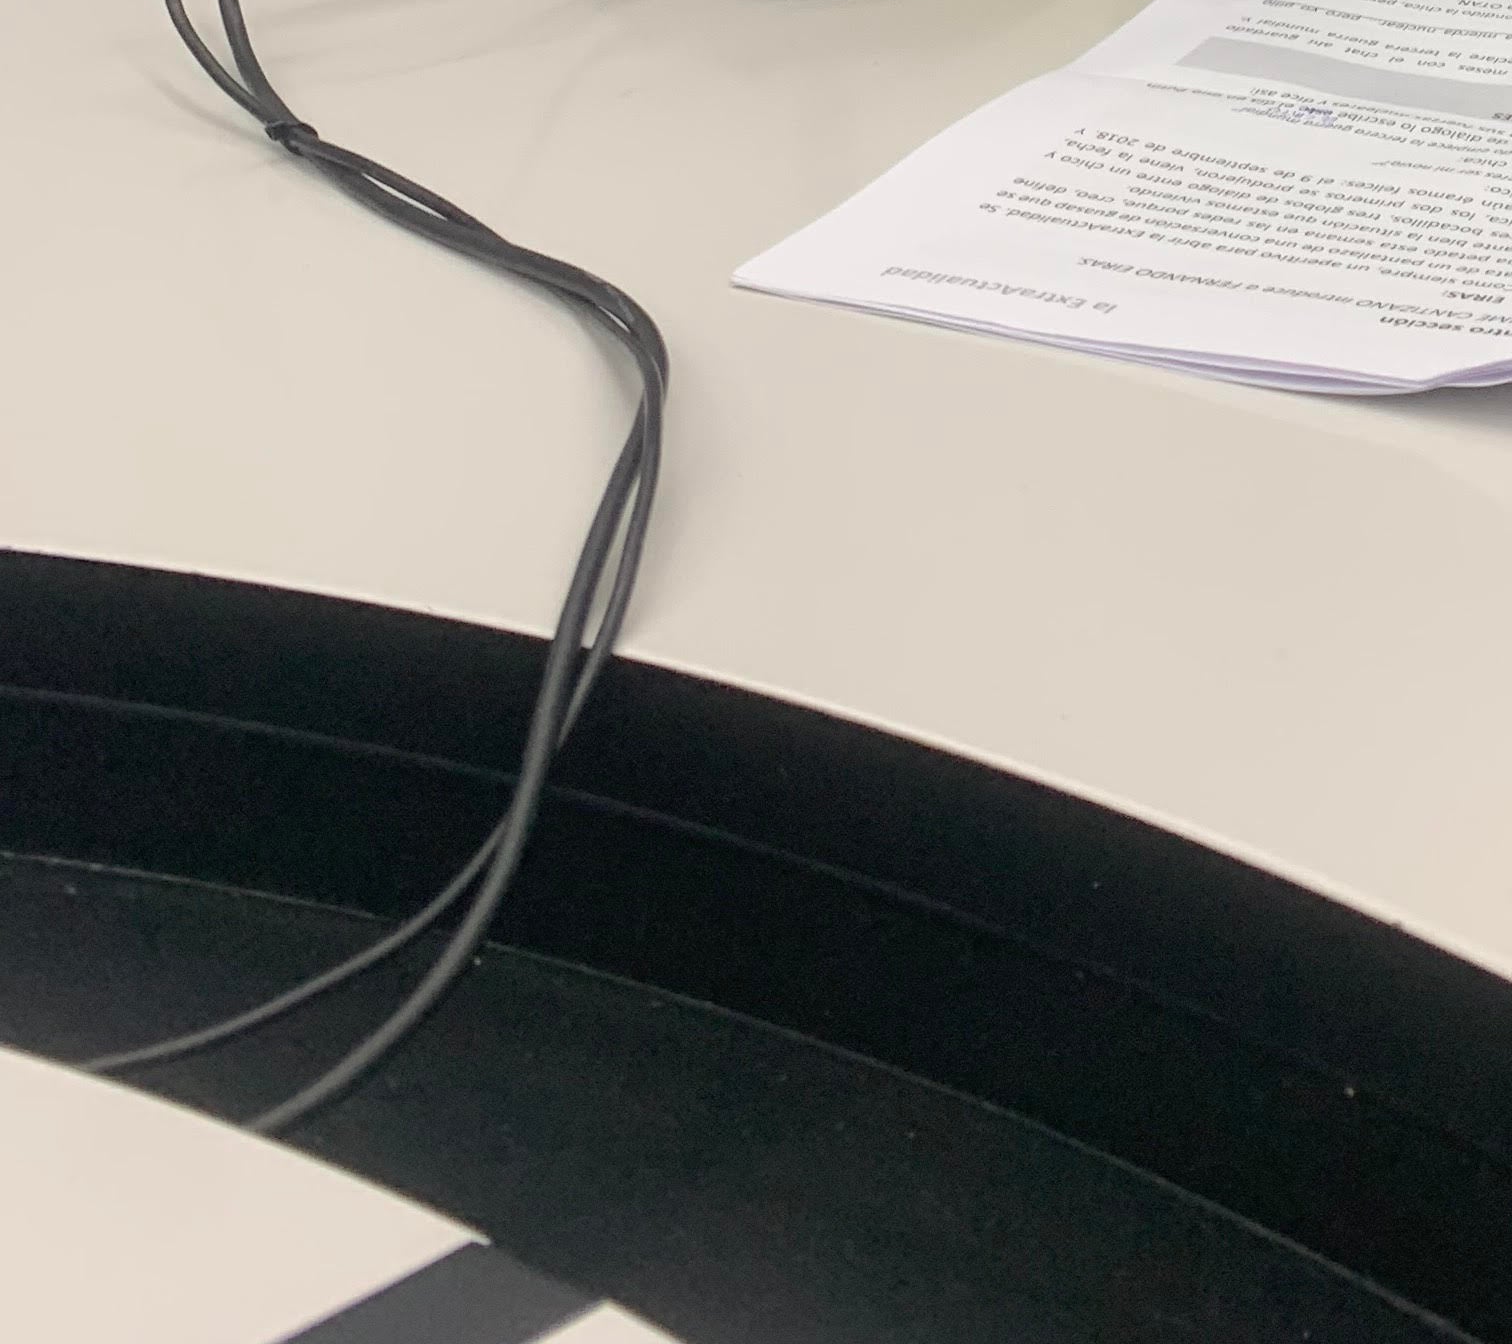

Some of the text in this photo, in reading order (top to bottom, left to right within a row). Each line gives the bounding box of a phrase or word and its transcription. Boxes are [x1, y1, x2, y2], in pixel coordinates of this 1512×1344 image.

[1143, 142, 1166, 152] de
[1044, 150, 1056, 158] y
[1117, 151, 1133, 161] la
[1060, 155, 1104, 169] chico
[1138, 157, 1184, 171] viene
[1171, 148, 1268, 173] septiembre
[1108, 165, 1131, 175] un
[1272, 169, 1295, 179] de
[1135, 172, 1182, 186] entre
[1315, 177, 1334, 185] el
[1012, 177, 1067, 194] define
[1187, 182, 1251, 199] diálogo
[996, 190, 1016, 198] se
[1298, 188, 1320, 196] se
[1407, 188, 1474, 204] éramos
[1017, 194, 1052, 206] que
[1255, 195, 1279, 203] de
[1324, 192, 1405, 208] primeros
[978, 202, 1001, 213] Se
[1053, 202, 1118, 217] guasap
[1204, 200, 1279, 217] estamos
[1283, 199, 1344, 213] globos
[1410, 203, 1443, 213] dos
[1118, 213, 1141, 222] de
[1192, 211, 1242, 225] redes
[1283, 213, 1317, 223] que
[1346, 209, 1381, 220] tres
[1450, 209, 1476, 221] los
[1005, 207, 1145, 237] ExtraActualidad.
[1245, 220, 1271, 231] las
[1321, 219, 1402, 237] situación
[1143, 217, 1260, 242] conversación
[1275, 225, 1298, 233] en
[1148, 232, 1165, 241] la
[1167, 236, 1212, 248] abrir
[1263, 237, 1298, 248] una
[1304, 230, 1374, 245] semana
[1406, 232, 1423, 241] la
[1427, 235, 1468, 247] bien
[1215, 244, 1258, 256] para
[1301, 244, 1324, 253] de
[1379, 242, 1418, 252] esta
[1259, 251, 1342, 267] aperitivo
[1327, 247, 1425, 266] pantallazo
[1423, 248, 1491, 261] petado
[1345, 263, 1370, 271] un
[1427, 262, 1451, 270] un
[1455, 265, 1480, 274] de
[879, 266, 1117, 314] la ExtraActualidad
[1379, 316, 1464, 331] sección
